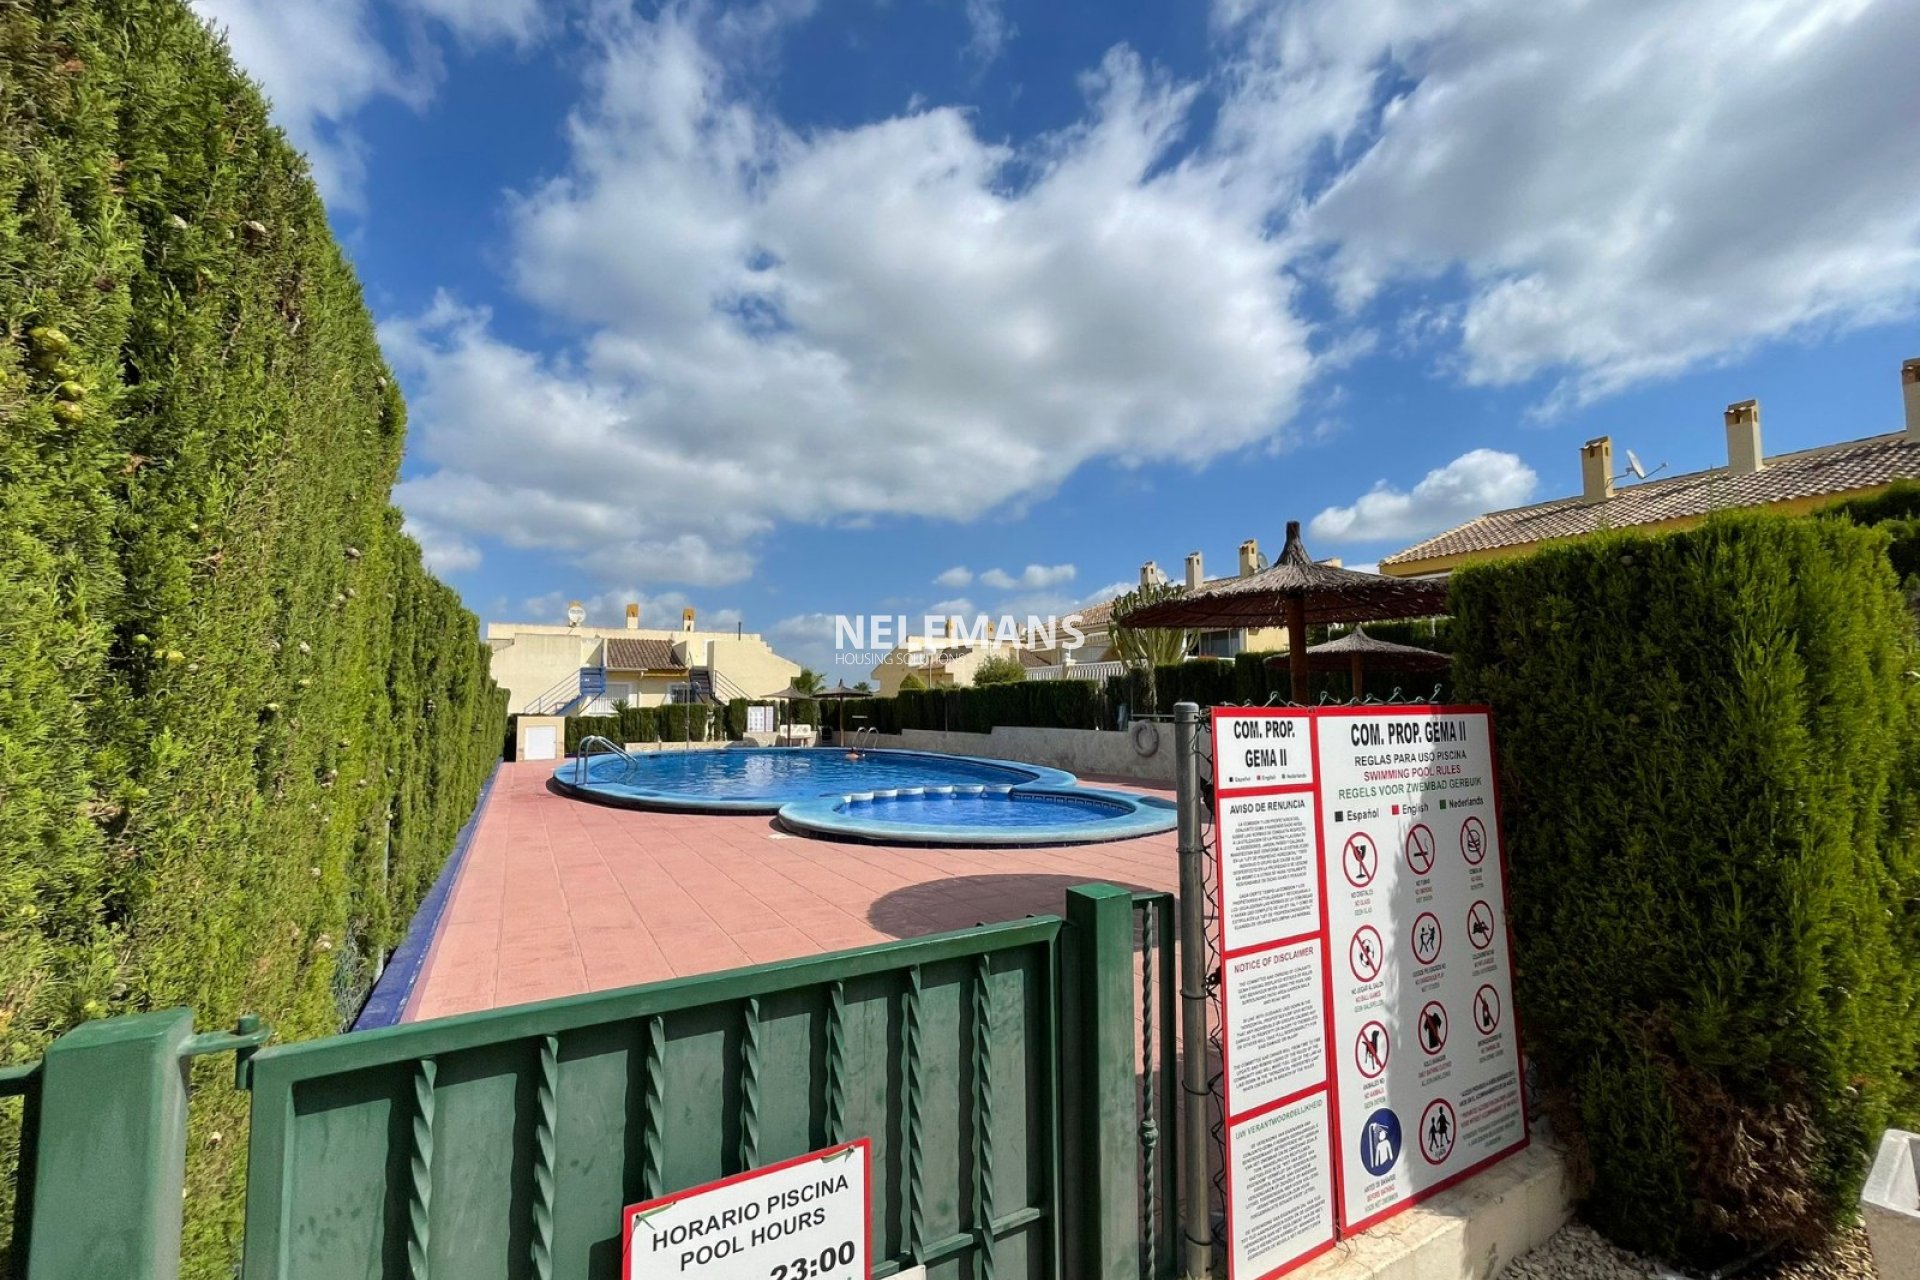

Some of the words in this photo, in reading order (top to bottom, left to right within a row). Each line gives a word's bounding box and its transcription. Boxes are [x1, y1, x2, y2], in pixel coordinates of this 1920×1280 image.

[1234, 720, 1262, 739] COM.
[1265, 720, 1295, 738] PROP.
[1351, 723, 1384, 746] COM.
[1388, 722, 1422, 745] PROP.
[1425, 721, 1457, 743] GEMA
[1459, 721, 1466, 741] II
[1245, 749, 1277, 767] GEMA
[1280, 749, 1287, 766] II
[1355, 754, 1391, 766] REGLAS
[1394, 752, 1417, 764] PARA
[1418, 751, 1435, 762] USO
[1437, 750, 1467, 761] PISCINA
[1364, 767, 1410, 782] SWIMMING
[1412, 766, 1434, 777] POOL
[1436, 764, 1461, 776] RULES
[1339, 787, 1376, 800] REGELS
[1379, 784, 1404, 796] VOOR
[1406, 780, 1447, 793] ZWEMBAD
[1230, 803, 1254, 814] AVISO
[1255, 802, 1266, 812] DE
[1267, 800, 1305, 811] RENUNCIA
[1347, 808, 1379, 822] Español
[1403, 803, 1428, 815] English
[1450, 796, 1484, 809] Nederlands
[1234, 958, 1261, 973] NOTICE
[1262, 957, 1272, 967] OF
[1273, 946, 1314, 964] DISCLAIMER
[653, 1202, 760, 1251] HORARIO
[767, 1174, 849, 1214] PISCINA
[681, 1236, 744, 1272] POOL
[751, 1207, 825, 1247] HOURS
[770, 1240, 855, 1280] 23:00
